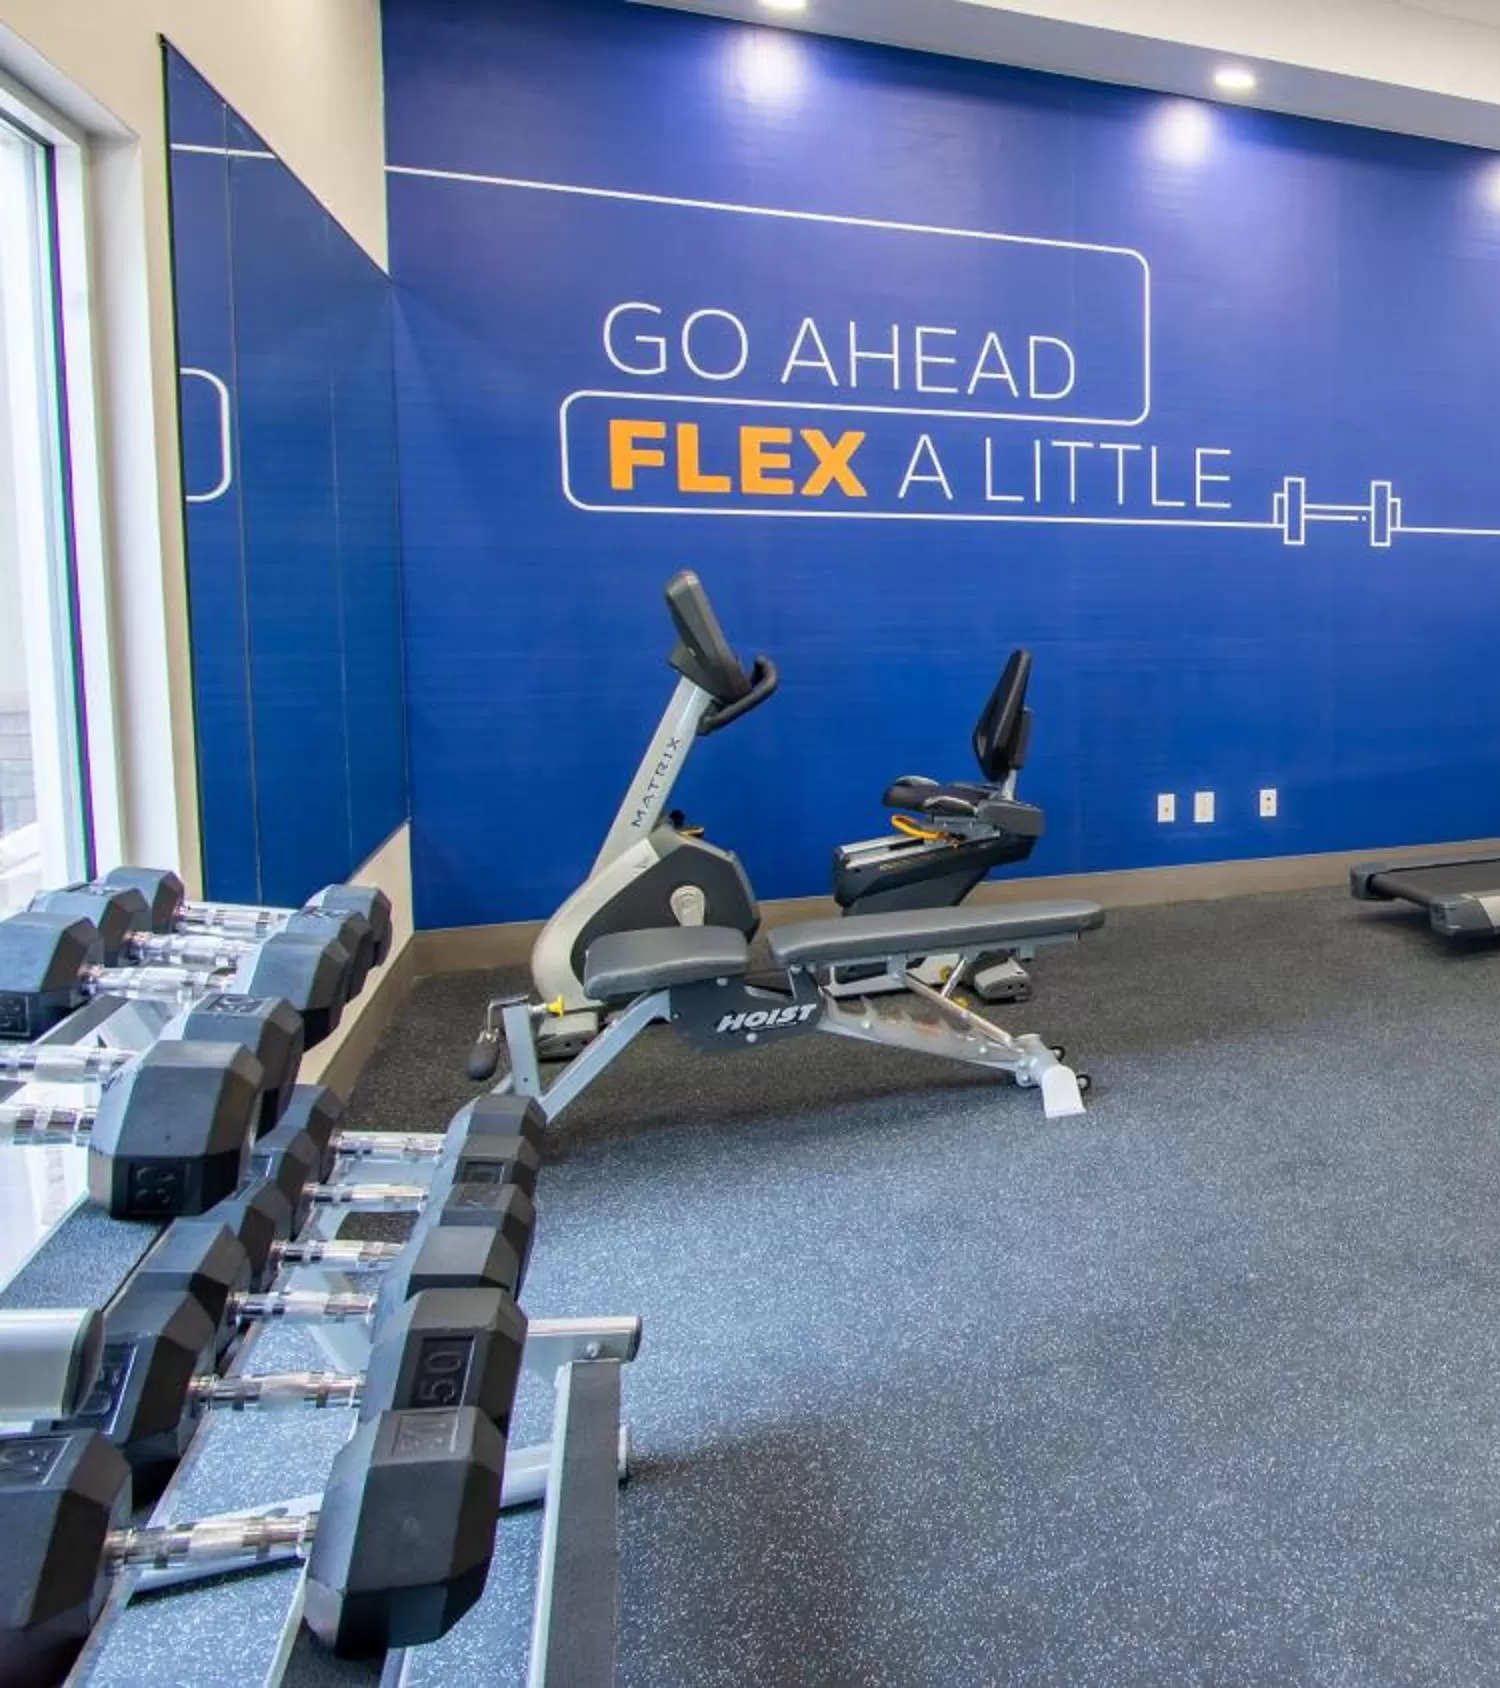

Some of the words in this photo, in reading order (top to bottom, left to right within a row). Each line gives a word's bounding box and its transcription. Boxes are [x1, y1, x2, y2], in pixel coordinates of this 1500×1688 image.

[603, 301, 749, 381] GO
[780, 317, 1075, 399] AHEAD
[608, 419, 867, 498] FLEX
[897, 433, 953, 500] A
[985, 437, 1232, 508] LITTLE
[631, 736, 681, 828] MATRIX
[716, 1003, 817, 1032] HOIST
[420, 1351, 462, 1404] 50
